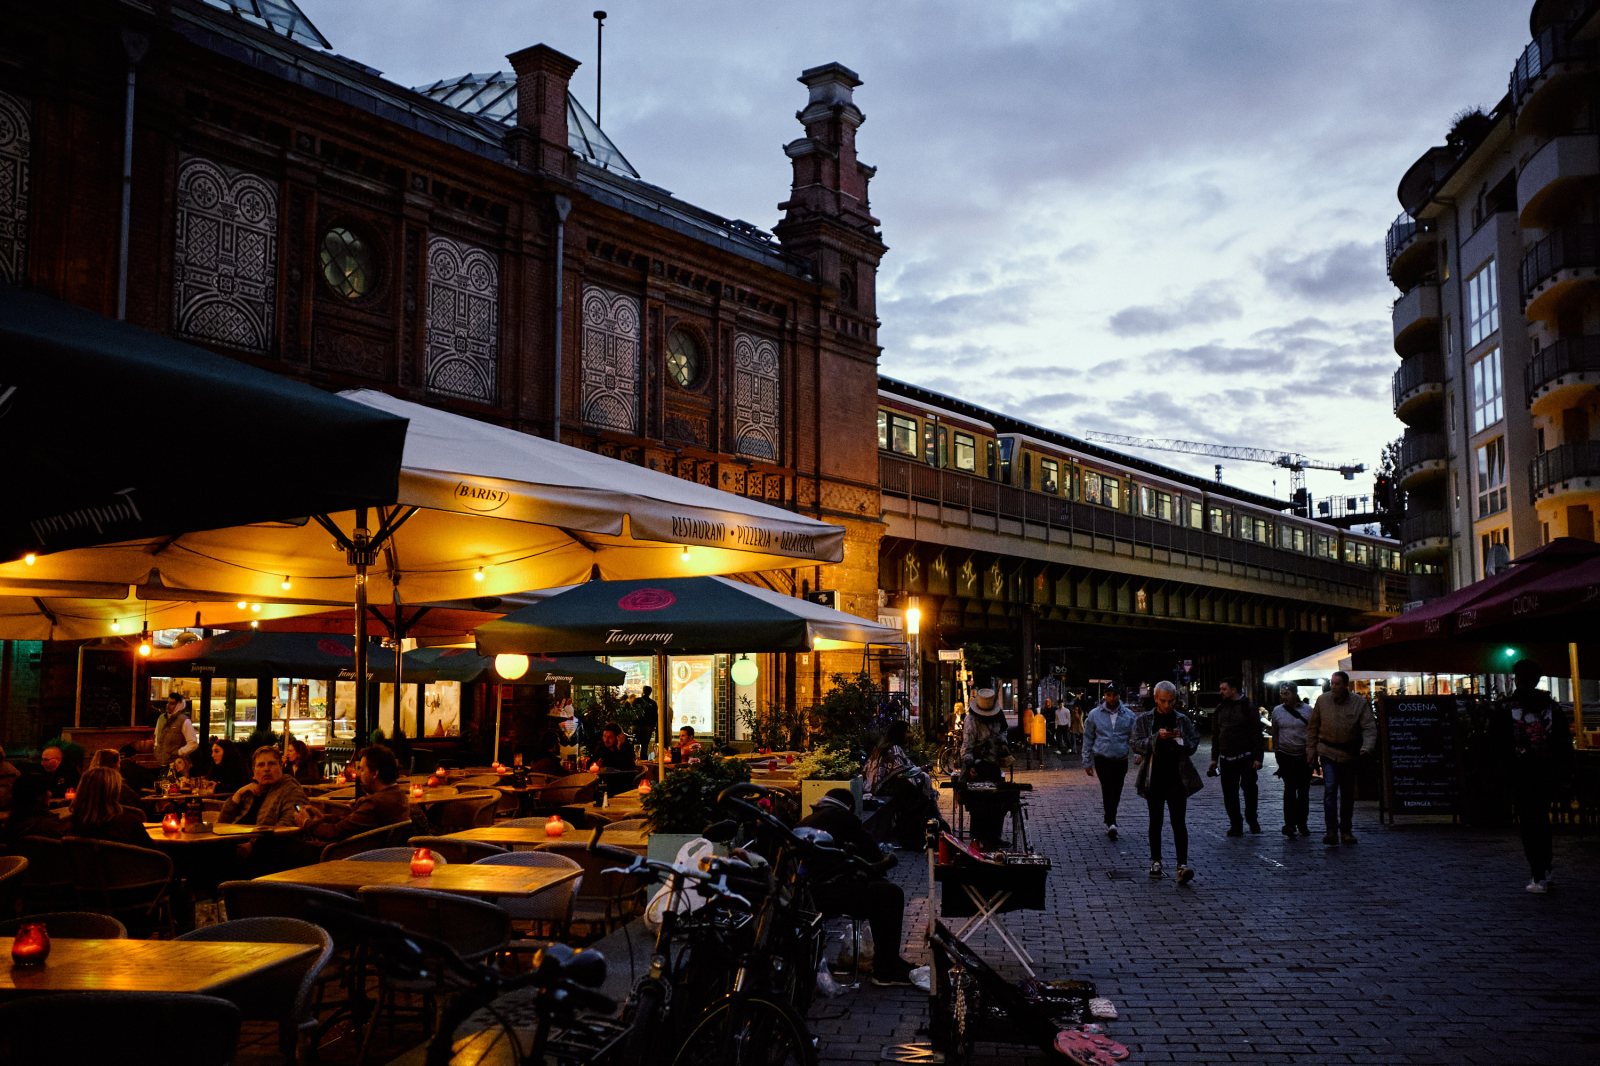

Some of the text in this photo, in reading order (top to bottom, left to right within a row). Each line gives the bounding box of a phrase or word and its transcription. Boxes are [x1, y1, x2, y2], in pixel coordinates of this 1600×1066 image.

[459, 485, 507, 502] BARIST
[671, 516, 816, 555] RESTAURANT PIZZERIA GELATERIA
[605, 628, 674, 646] Tanqueray
[1398, 702, 1438, 712] OSSENA
